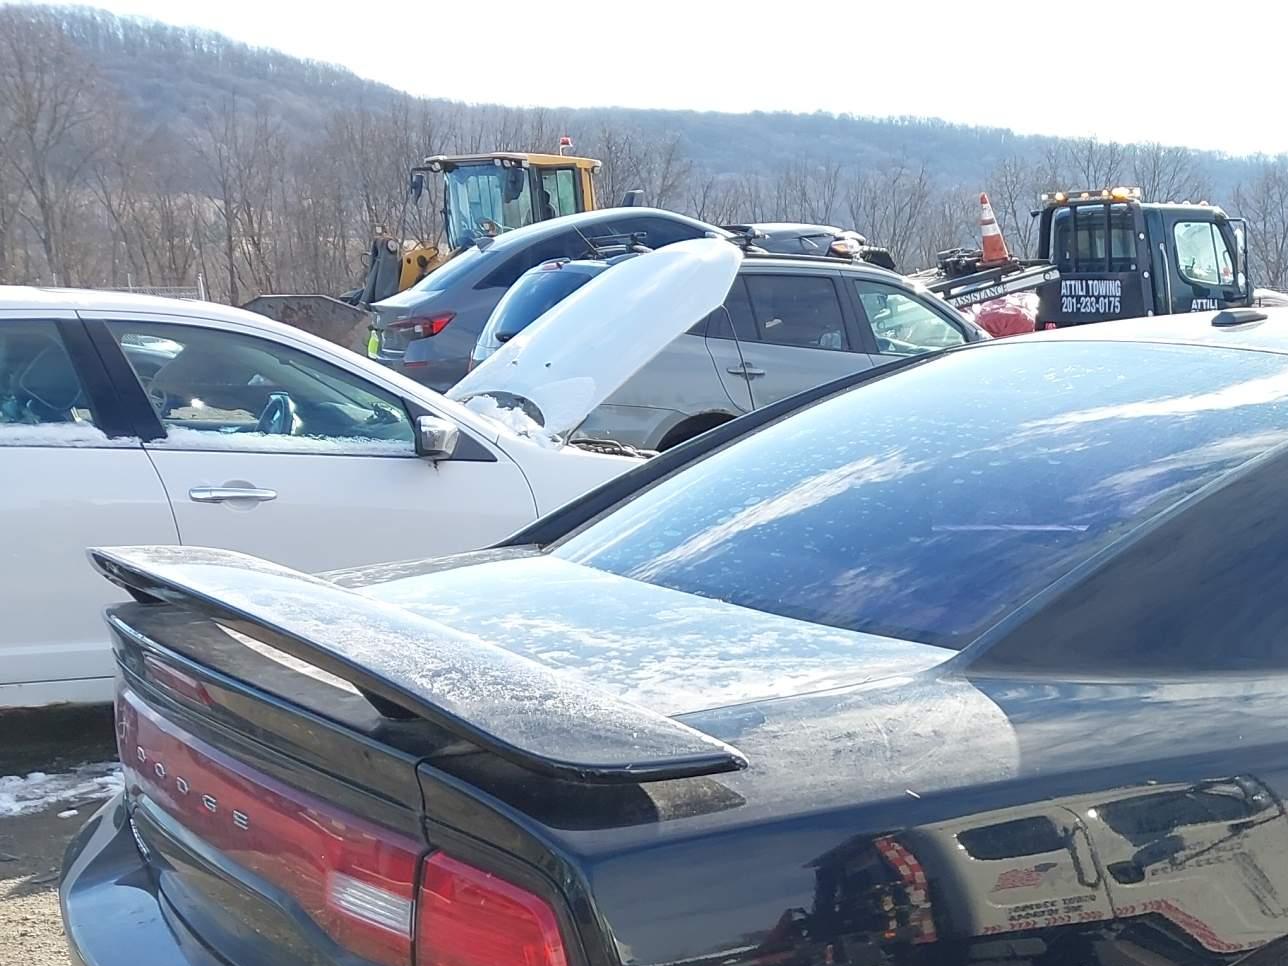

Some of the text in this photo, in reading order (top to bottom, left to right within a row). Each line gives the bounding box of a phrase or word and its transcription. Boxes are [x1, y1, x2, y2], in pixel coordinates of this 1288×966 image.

[1061, 280, 1121, 296] ATTILI TOWING
[1061, 296, 1121, 313] 201-233-0175
[1191, 298, 1218, 310] ATTILI
[137, 745, 249, 831] DODGE
